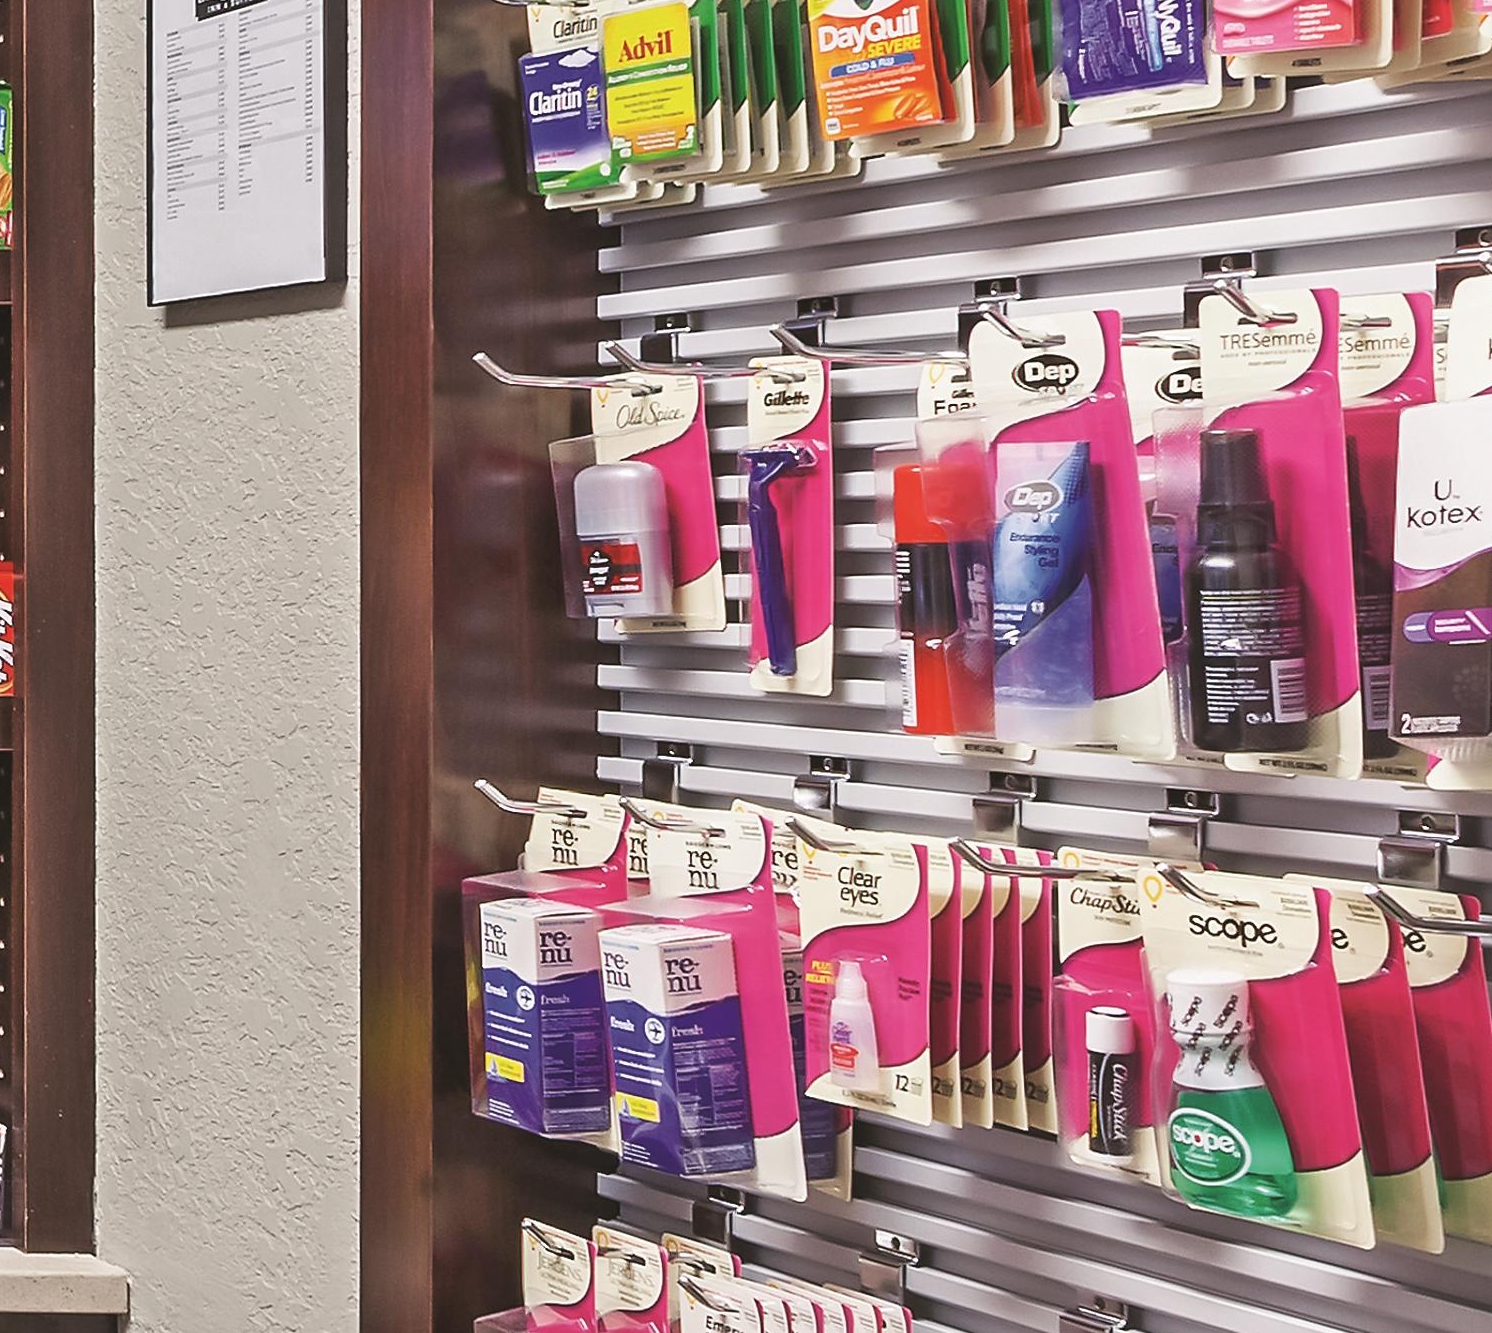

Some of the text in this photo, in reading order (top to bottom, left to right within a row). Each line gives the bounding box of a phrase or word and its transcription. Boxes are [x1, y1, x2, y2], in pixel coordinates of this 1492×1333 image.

[553, 15, 597, 38] Claritin
[817, 5, 920, 53] DayQuil
[618, 31, 674, 62] Advil
[867, 35, 921, 56] SEVERE
[529, 87, 582, 116] Claritin
[1220, 329, 1316, 350] TRESemmé
[1024, 361, 1075, 384] Dep
[764, 391, 809, 408] Gillette
[1012, 485, 1051, 507] Dep
[1434, 479, 1452, 501] U
[1407, 505, 1482, 528] kotex
[1024, 544, 1059, 557] Styling
[838, 867, 881, 887] Clear
[840, 886, 880, 906] eyes
[1189, 914, 1277, 947] scope
[895, 1074, 909, 1091] 12
[1112, 1062, 1127, 1141] ChapStick
